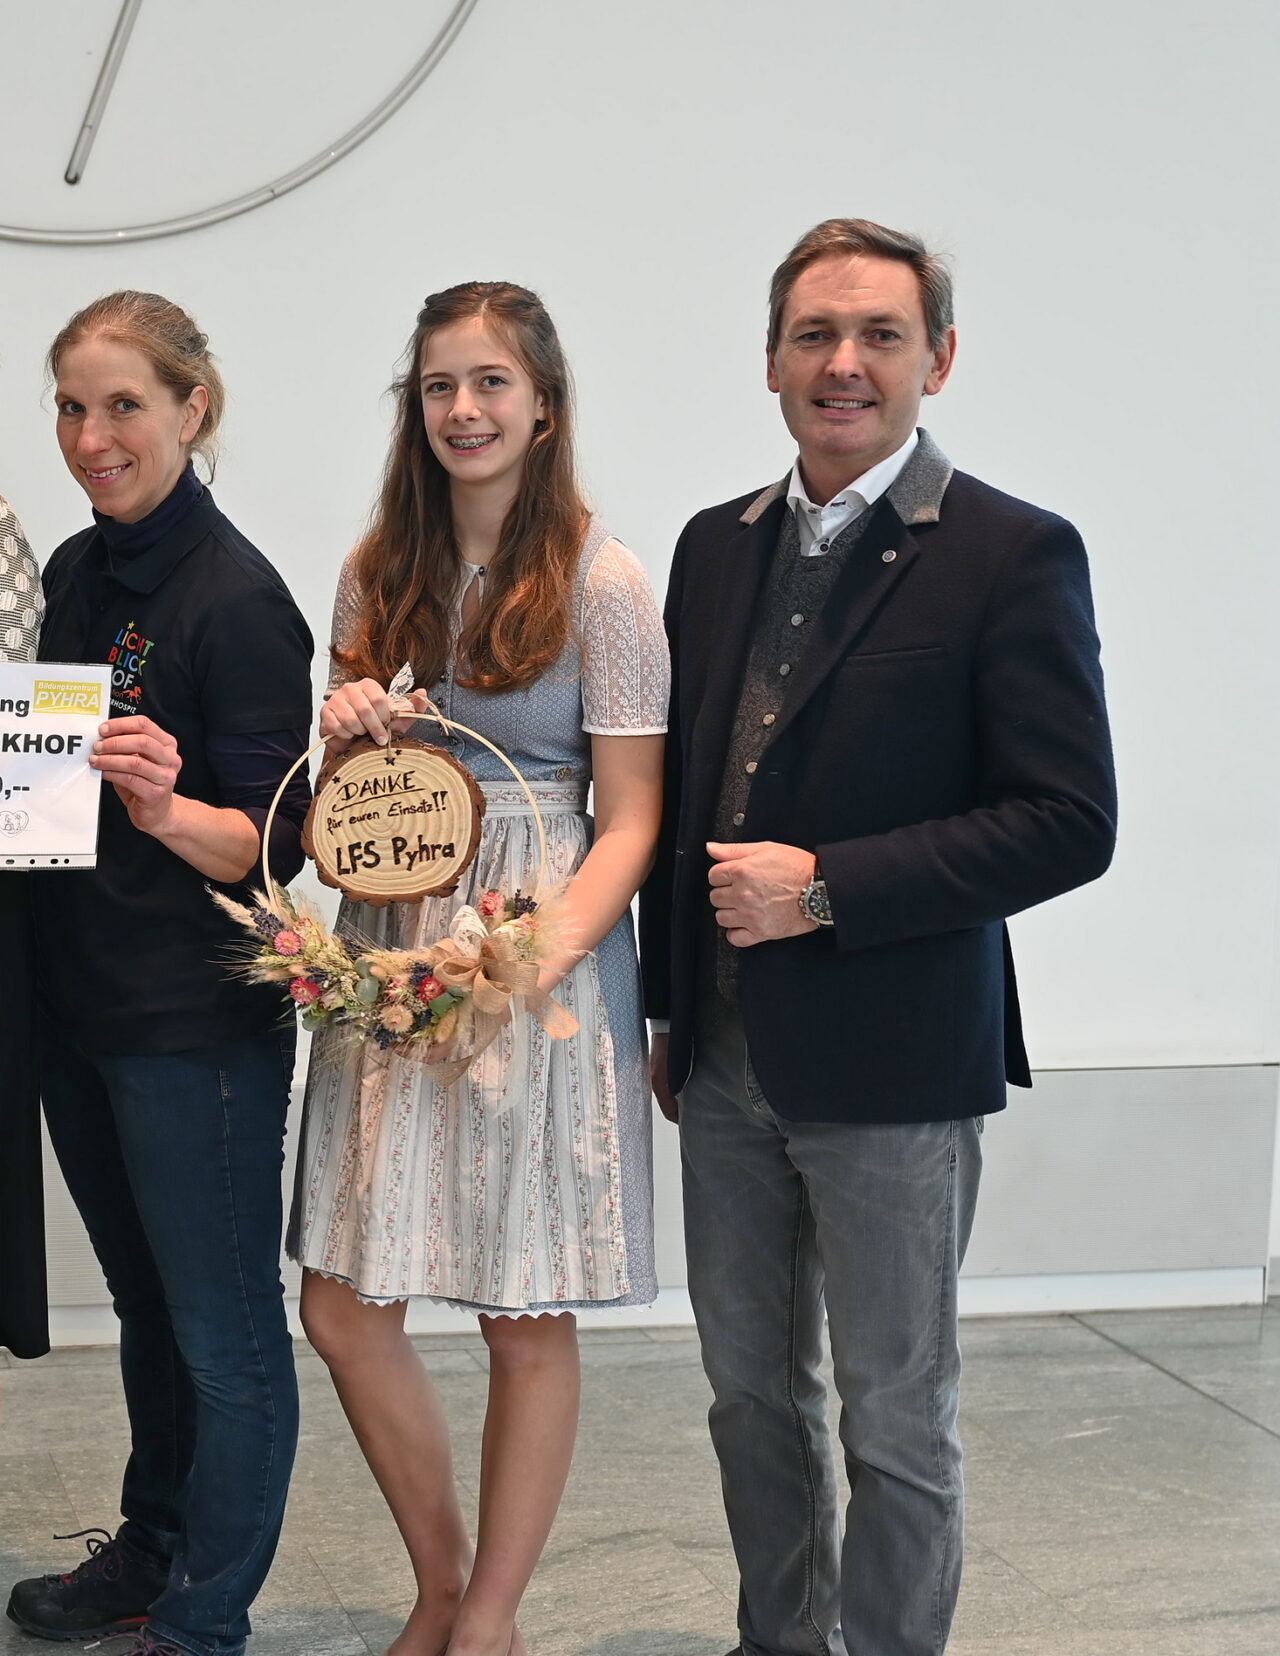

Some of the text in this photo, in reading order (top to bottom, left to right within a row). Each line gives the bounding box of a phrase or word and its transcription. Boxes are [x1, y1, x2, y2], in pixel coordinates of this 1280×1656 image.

[114, 628, 155, 657] LICHT
[107, 646, 147, 676] BLICK
[111, 669, 135, 690] OF
[35, 690, 100, 709] PYHRA
[110, 698, 137, 715] RHOSPIZ
[336, 770, 417, 802] DANKE
[326, 790, 449, 836] für euren Einsatz!!
[336, 834, 456, 876] LFS Pyhra
